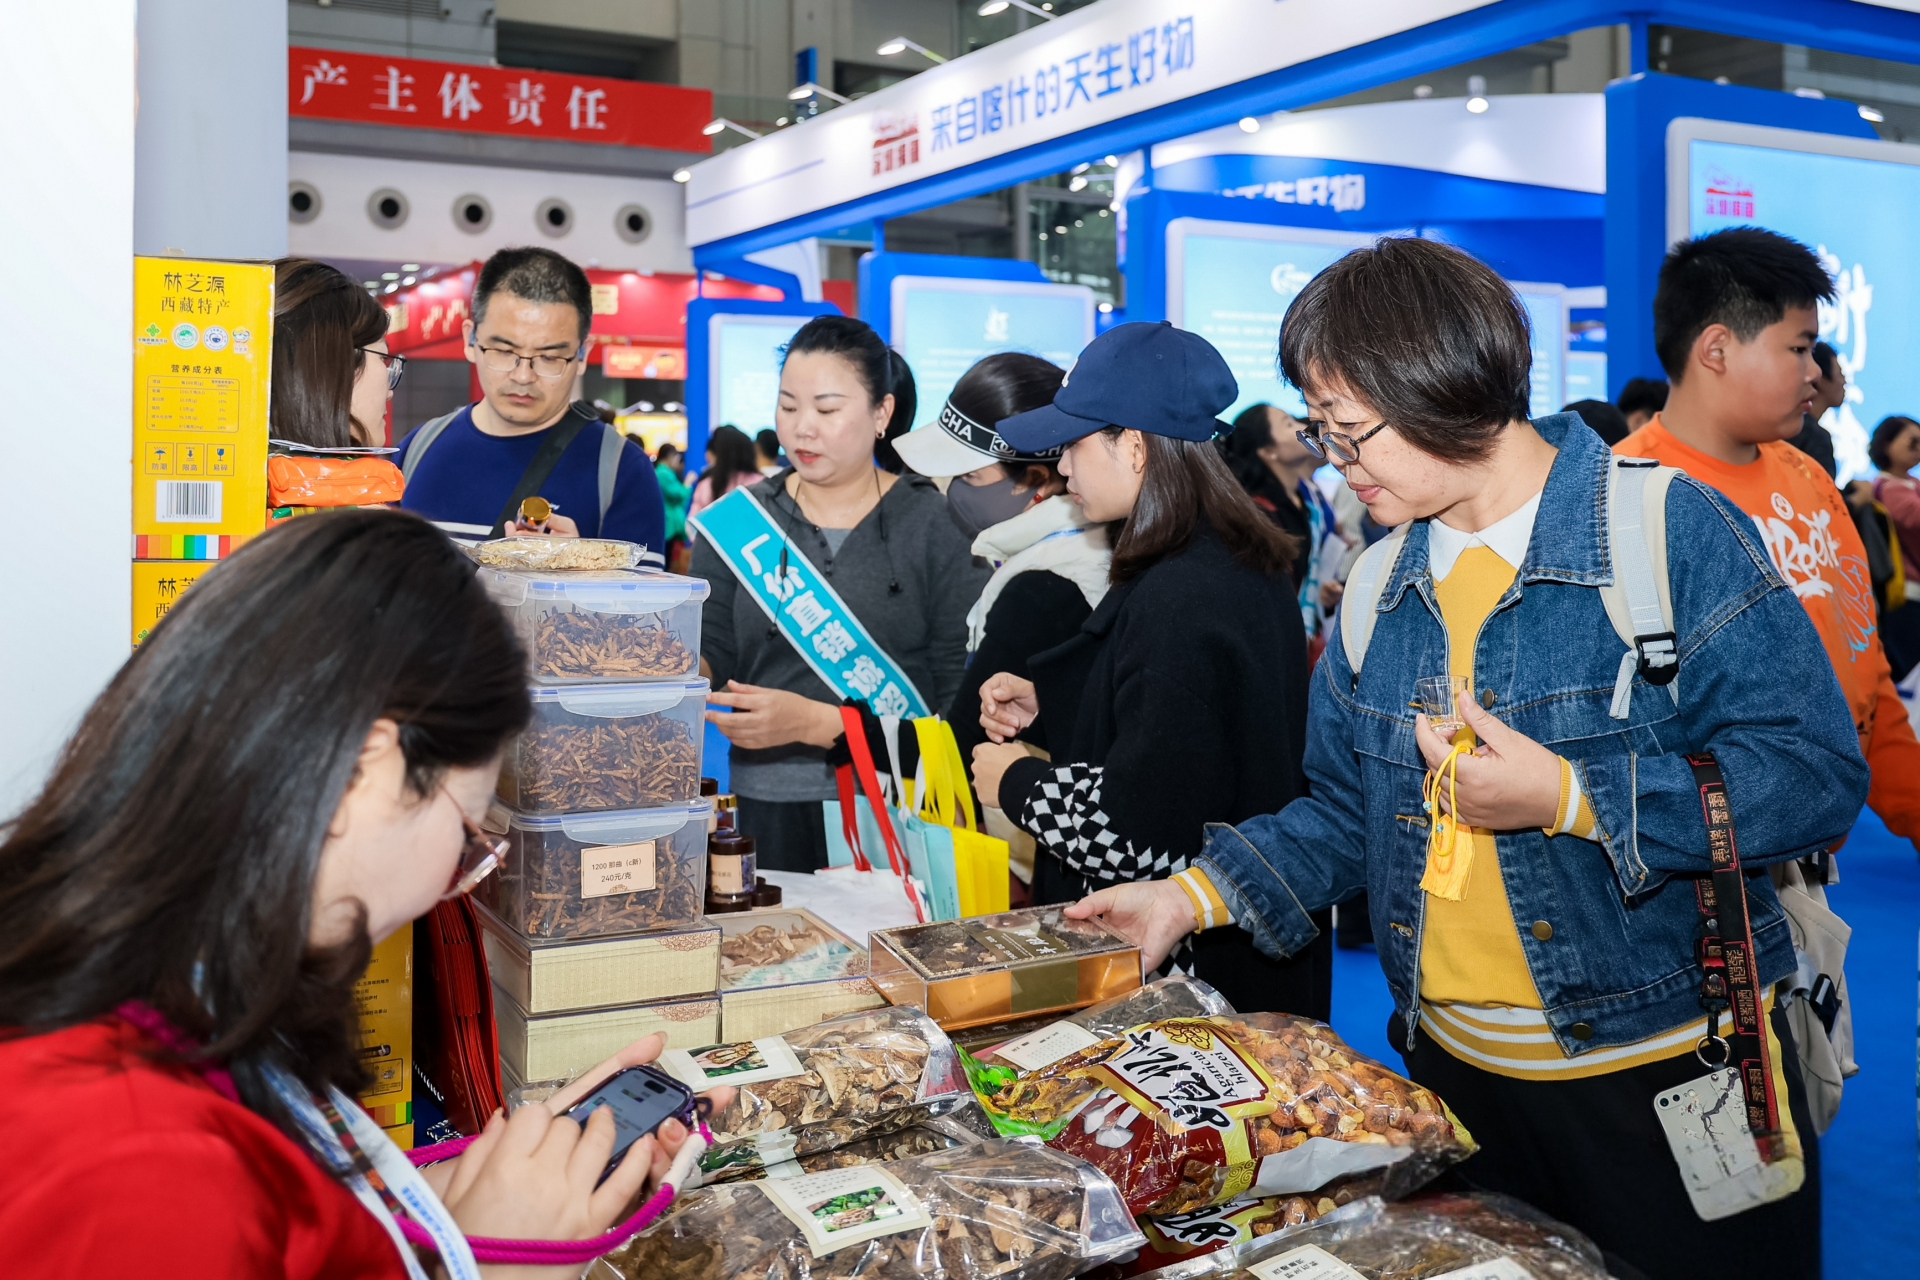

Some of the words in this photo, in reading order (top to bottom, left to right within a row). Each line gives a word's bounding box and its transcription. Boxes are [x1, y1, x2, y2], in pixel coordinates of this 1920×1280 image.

[300, 59, 609, 130] 产主体责任
[930, 15, 1194, 153] 来自喀什的天生好物
[164, 272, 225, 297] 林芝源
[161, 296, 230, 315] 西藏特产
[171, 364, 222, 375] 营养成分表
[592, 862, 607, 870] 1200
[601, 872, 632, 882] 240元/克
[1190, 1050, 1239, 1098] Agaricus
[1210, 1051, 1249, 1086] blazei
